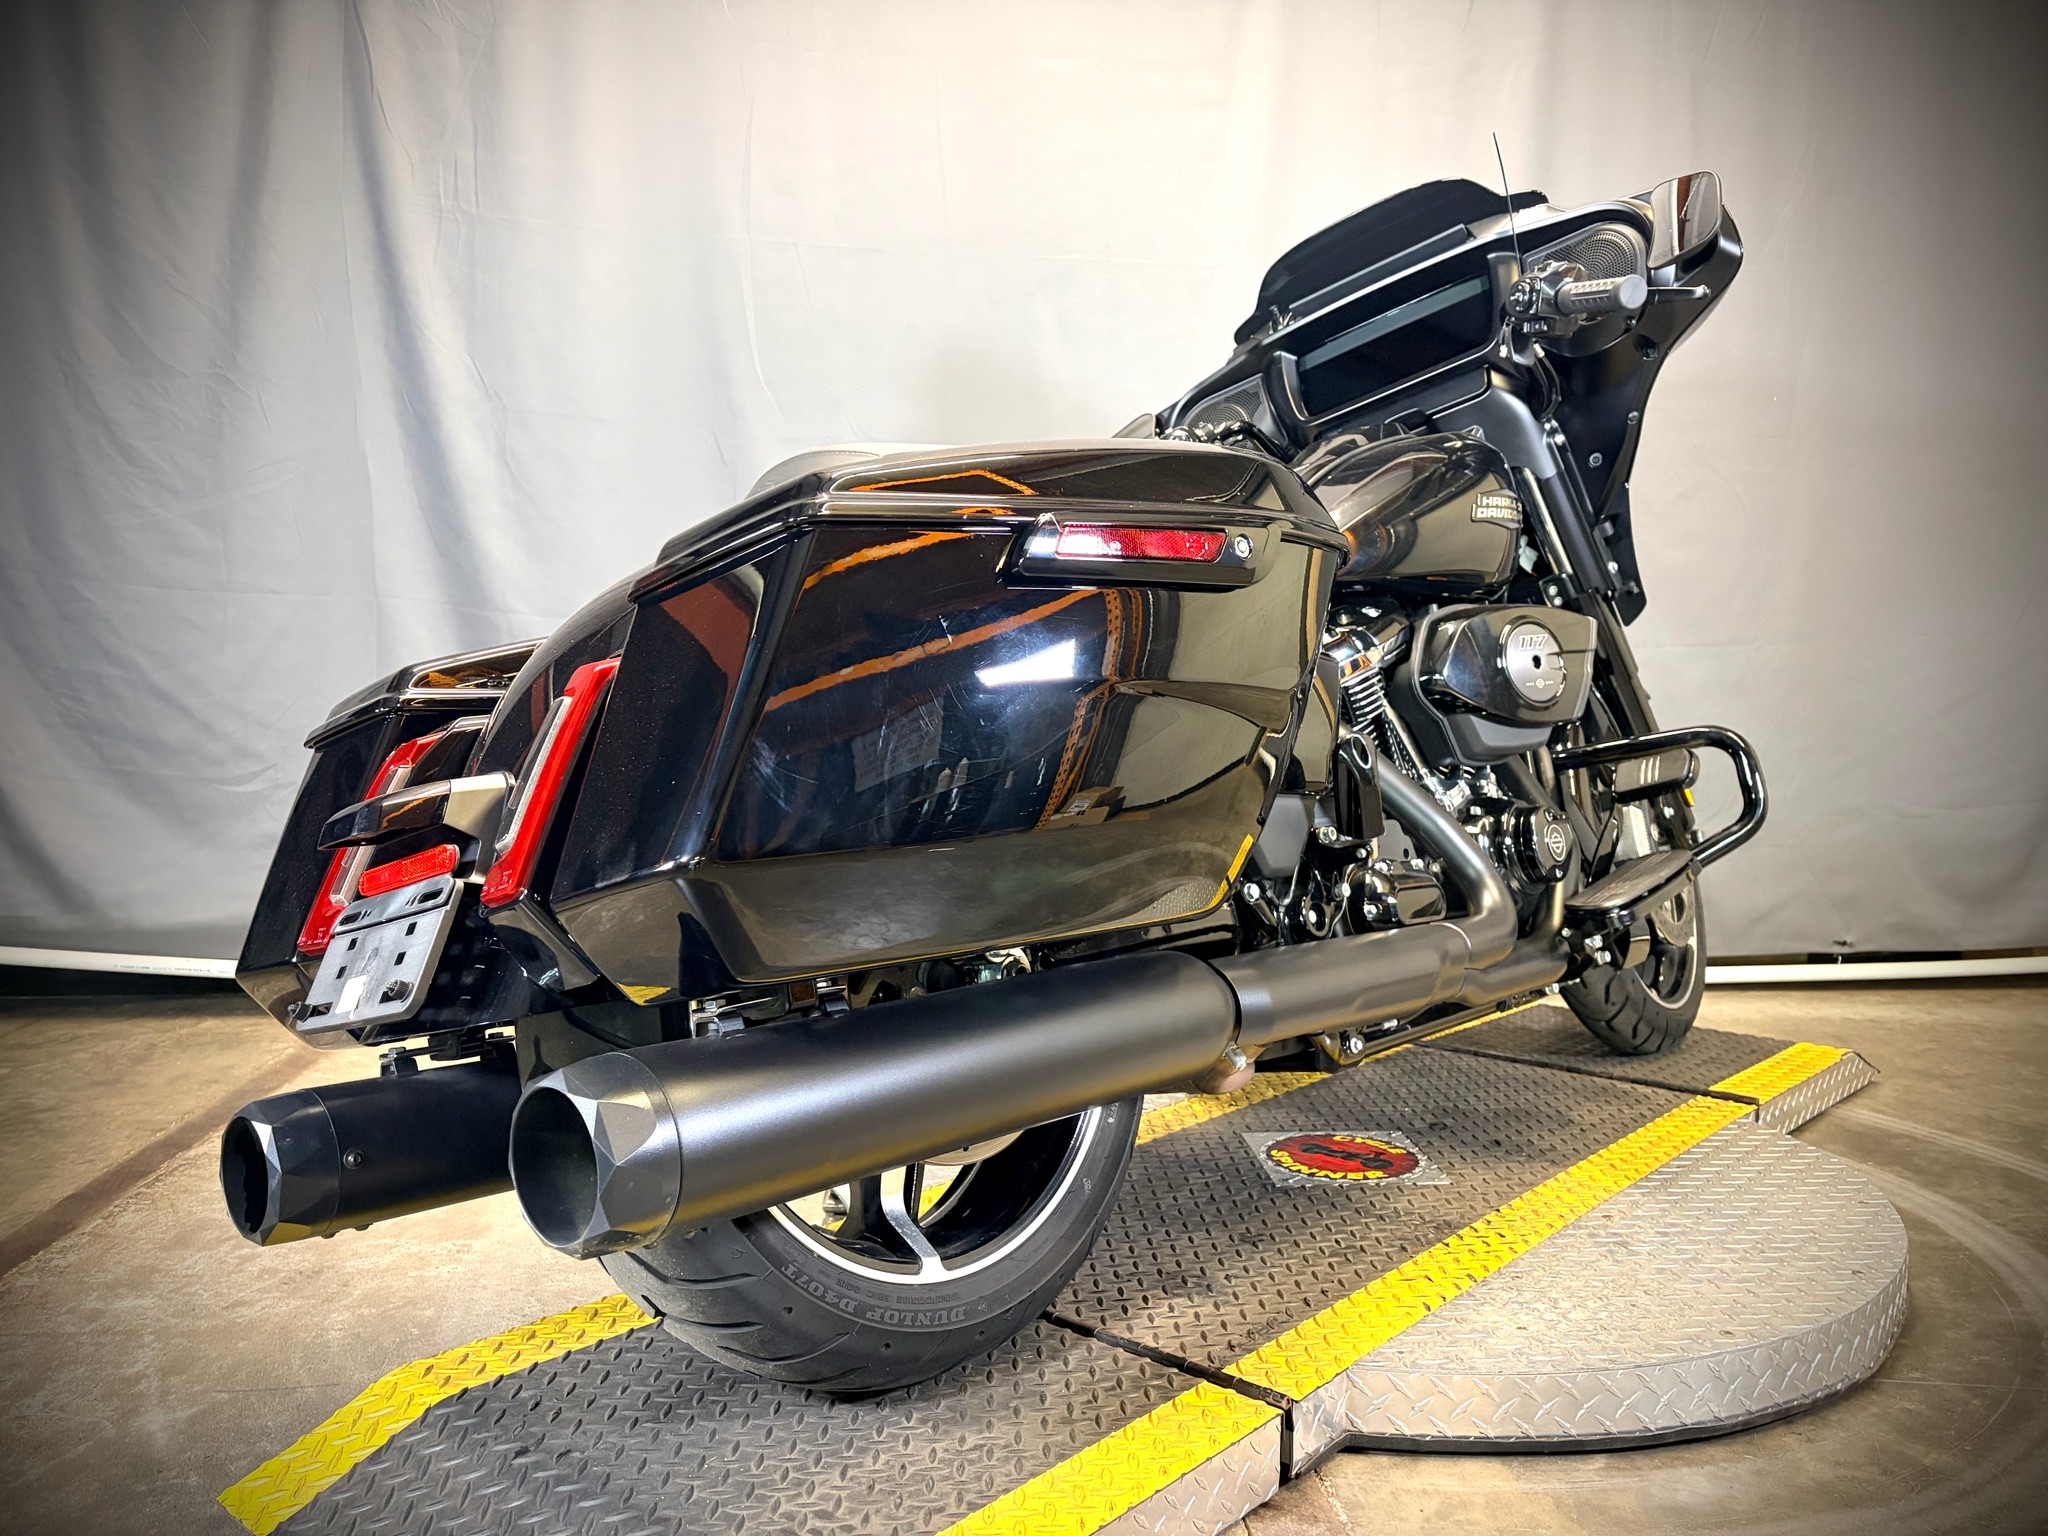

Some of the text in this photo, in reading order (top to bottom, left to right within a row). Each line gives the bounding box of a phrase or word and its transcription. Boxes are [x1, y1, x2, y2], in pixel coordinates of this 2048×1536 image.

[1519, 634, 1548, 650] 117
[1332, 1135, 1408, 1155] CYCLE
[1270, 1148, 1389, 1180] SPINNER
[780, 1263, 858, 1314] D407T
[865, 1306, 966, 1326] DUNLOP
